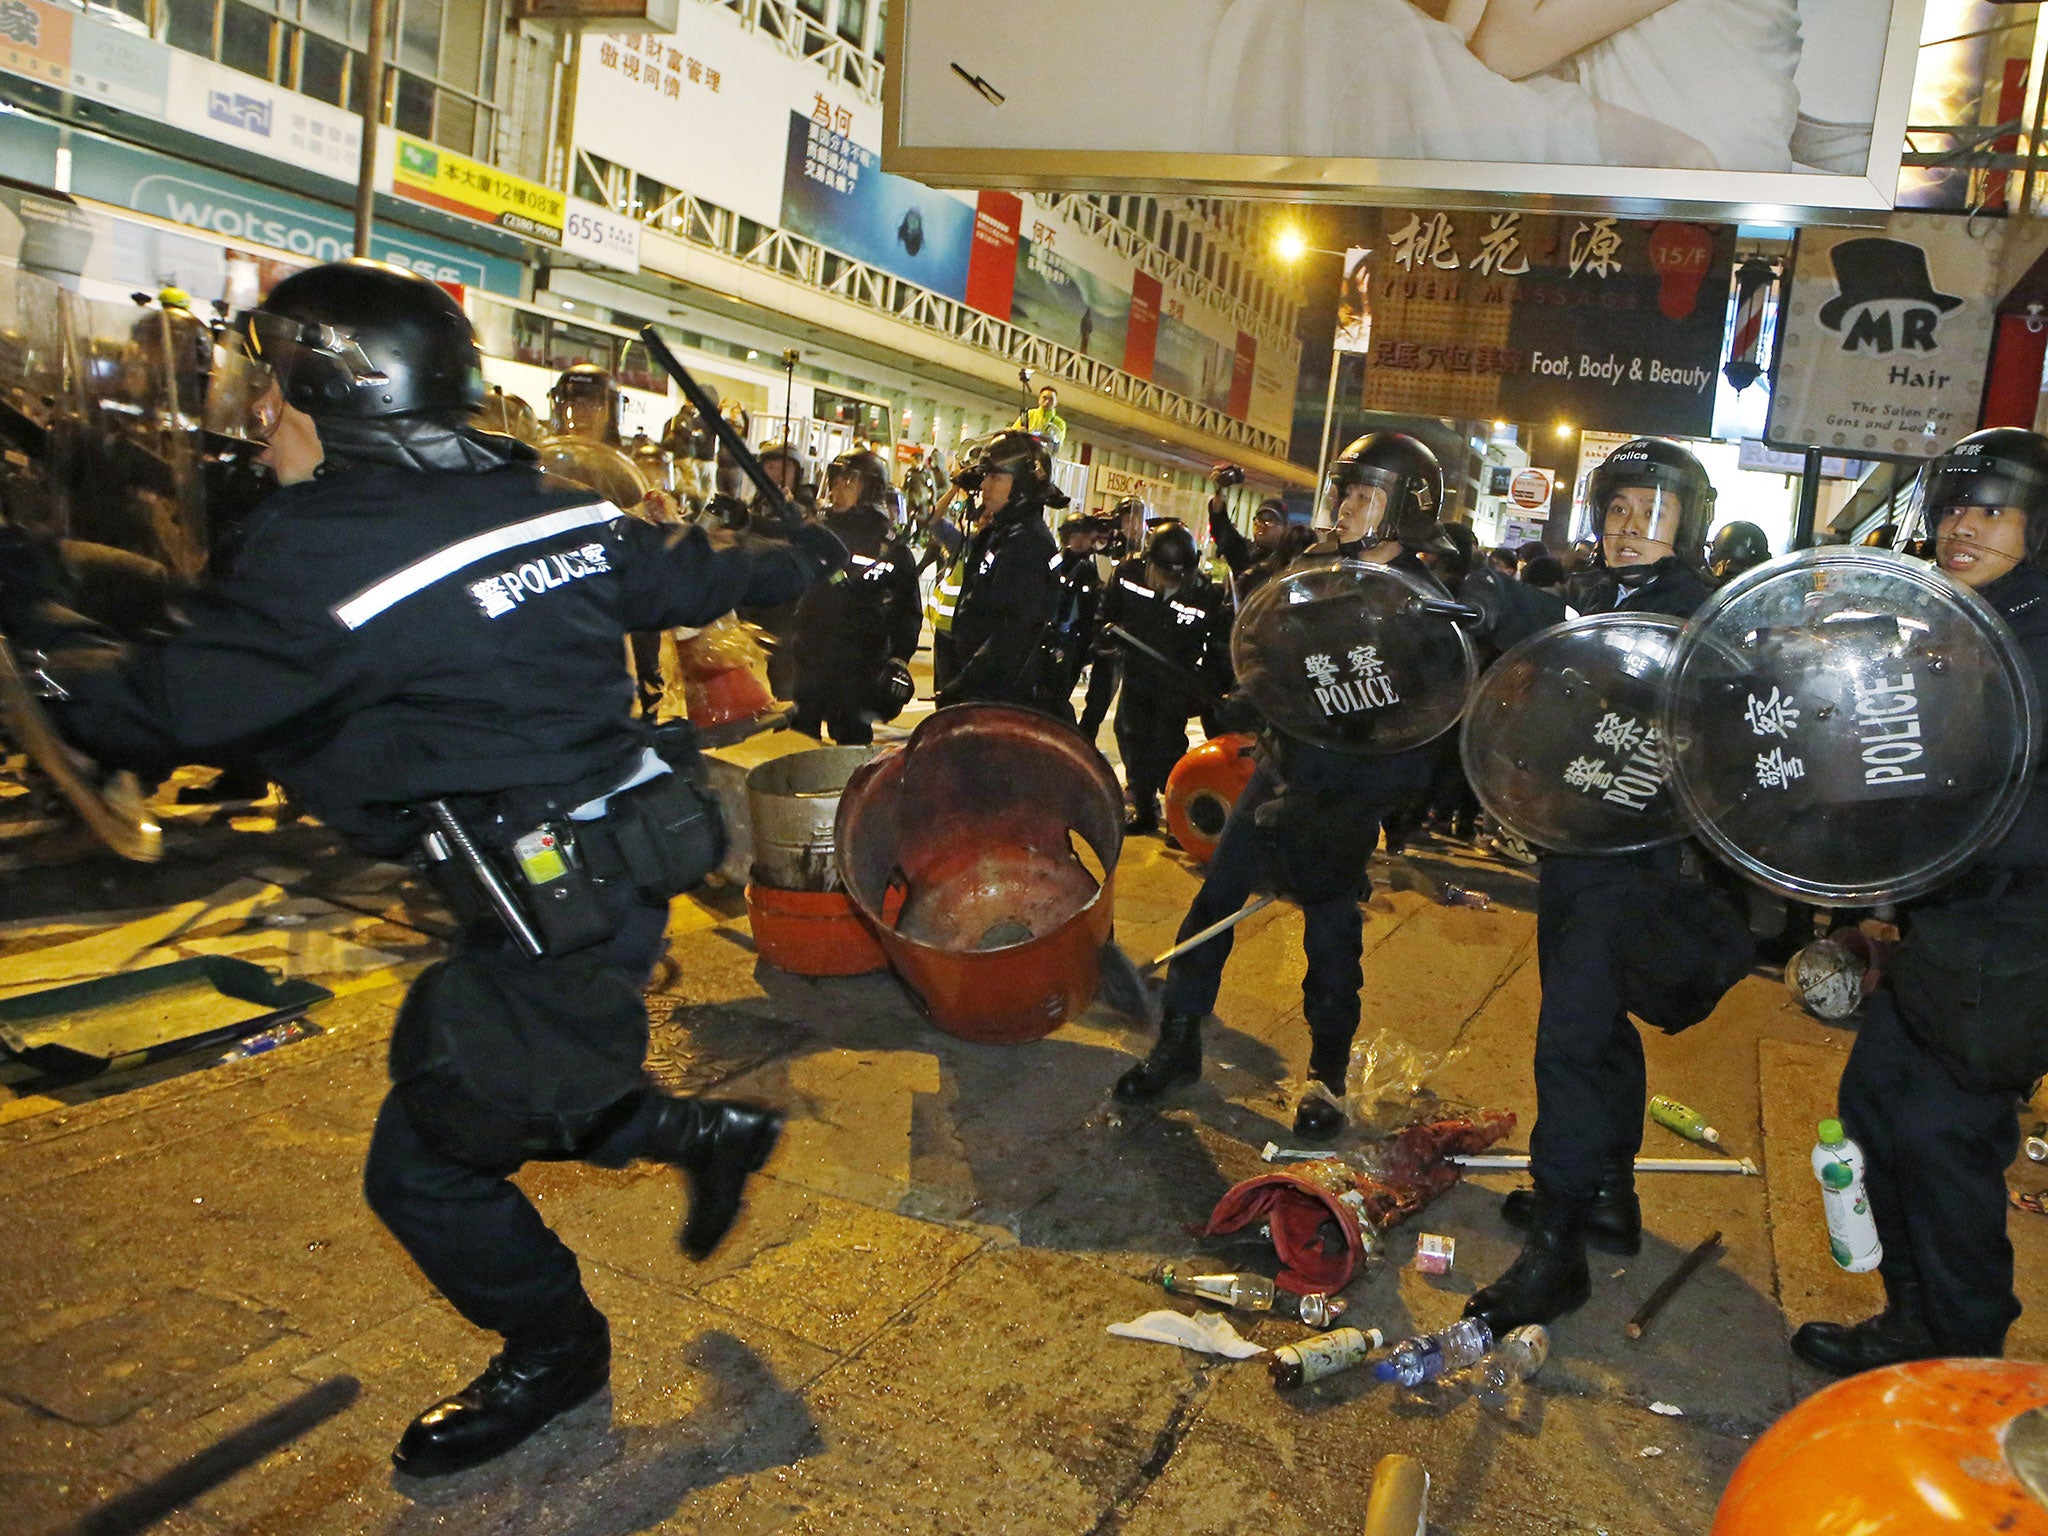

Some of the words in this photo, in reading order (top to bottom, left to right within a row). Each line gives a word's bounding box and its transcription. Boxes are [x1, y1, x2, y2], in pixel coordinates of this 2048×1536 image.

[606, 34, 720, 94] 豐財富管理
[812, 91, 853, 139] 為何
[166, 193, 357, 262] watsons
[568, 213, 604, 244] 655
[1386, 212, 1623, 279] 桃花源
[1659, 247, 1707, 265] 15/F
[1842, 308, 1938, 352] MR
[1532, 351, 1573, 380] Foot,
[1579, 353, 1625, 386] Body
[1629, 357, 1643, 381] &
[1650, 359, 1711, 393] Beauty
[1888, 365, 1951, 389] Hair
[1851, 401, 1877, 415] The
[1865, 419, 1893, 431] and
[1612, 451, 1649, 463] Police
[1107, 472, 1133, 493] HSBC
[1303, 645, 1385, 687] 警察
[1313, 674, 1400, 716] POLICE
[1744, 685, 1806, 790] 警察
[1855, 672, 1926, 785] POLICE
[1562, 712, 1644, 793] 警察
